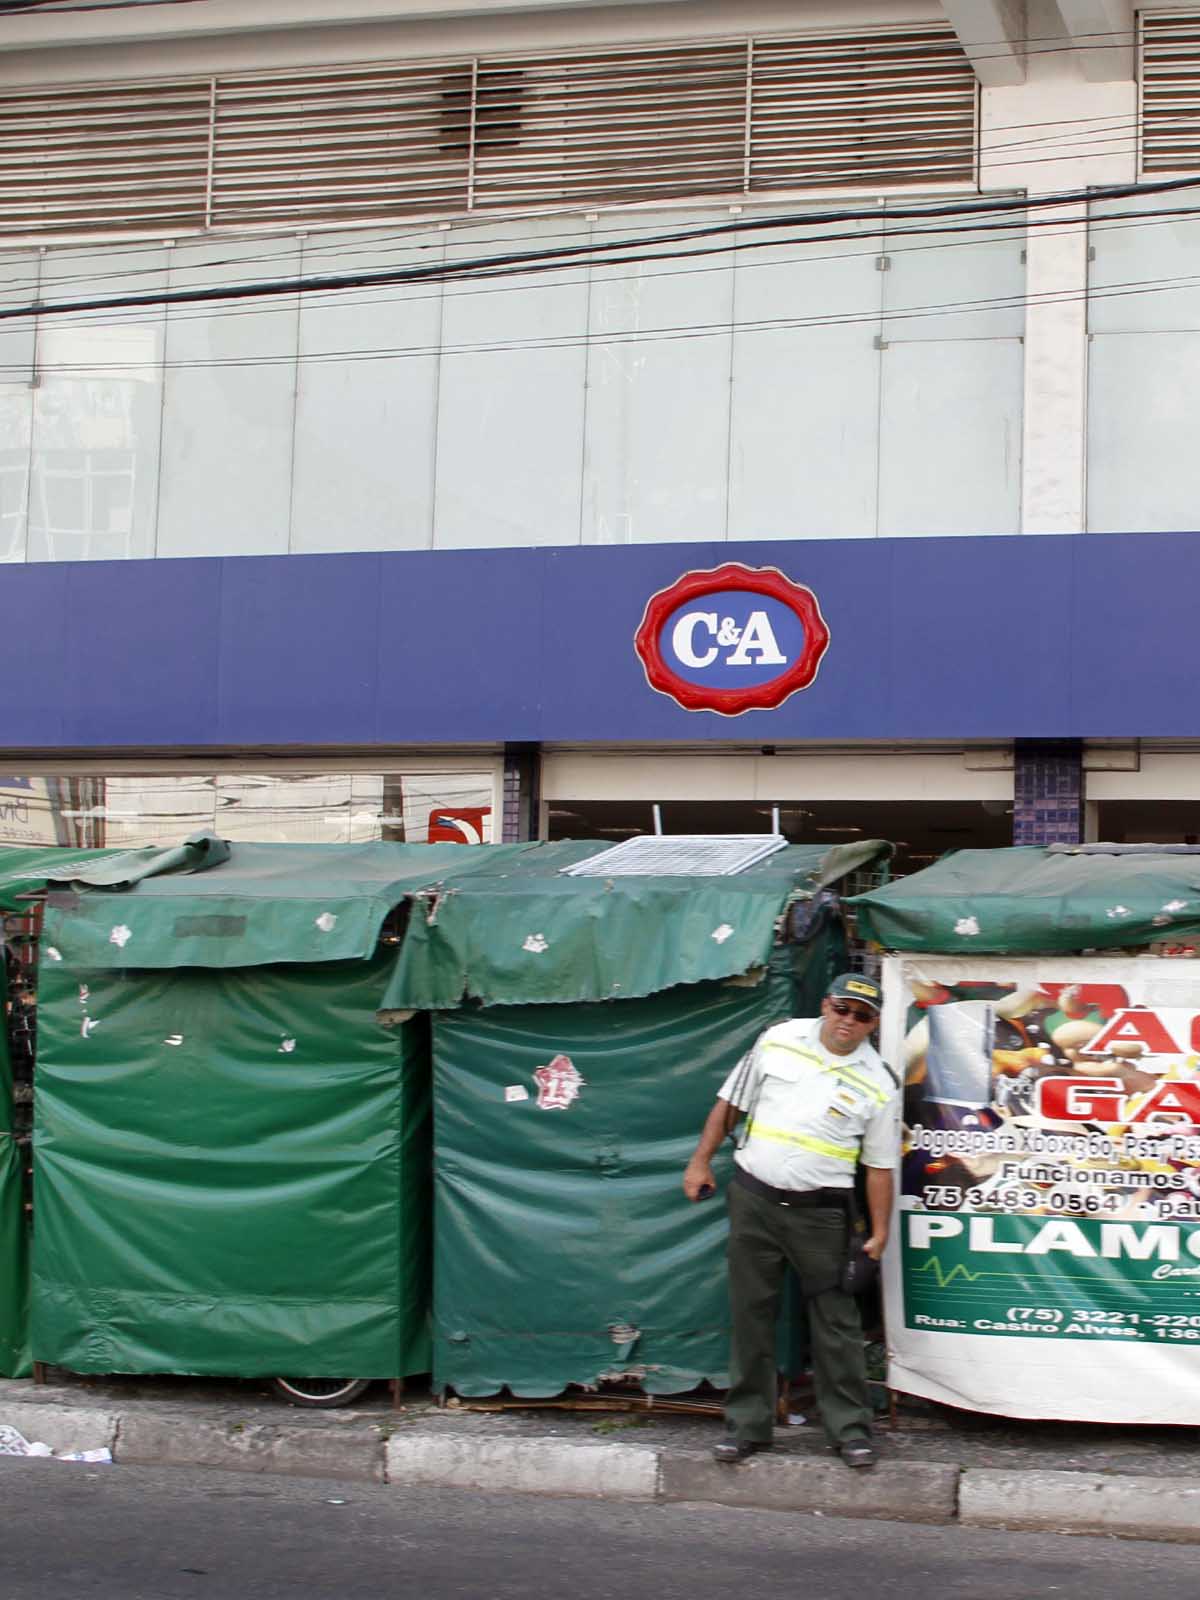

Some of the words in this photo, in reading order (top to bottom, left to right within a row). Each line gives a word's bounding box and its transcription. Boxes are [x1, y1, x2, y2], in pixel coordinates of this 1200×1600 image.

[672, 611, 787, 668] C&A
[911, 1125, 967, 1157] Jogos
[968, 1131, 1015, 1155] para
[1020, 1129, 1072, 1153] Xbox
[1002, 1163, 1186, 1187] Funcionamos
[926, 1186, 961, 1206] 75
[968, 1188, 1119, 1213] 3483-0564
[914, 1313, 967, 1328] Rua:
[973, 1319, 1059, 1333] Castro
[1006, 1307, 1064, 1323] (75)
